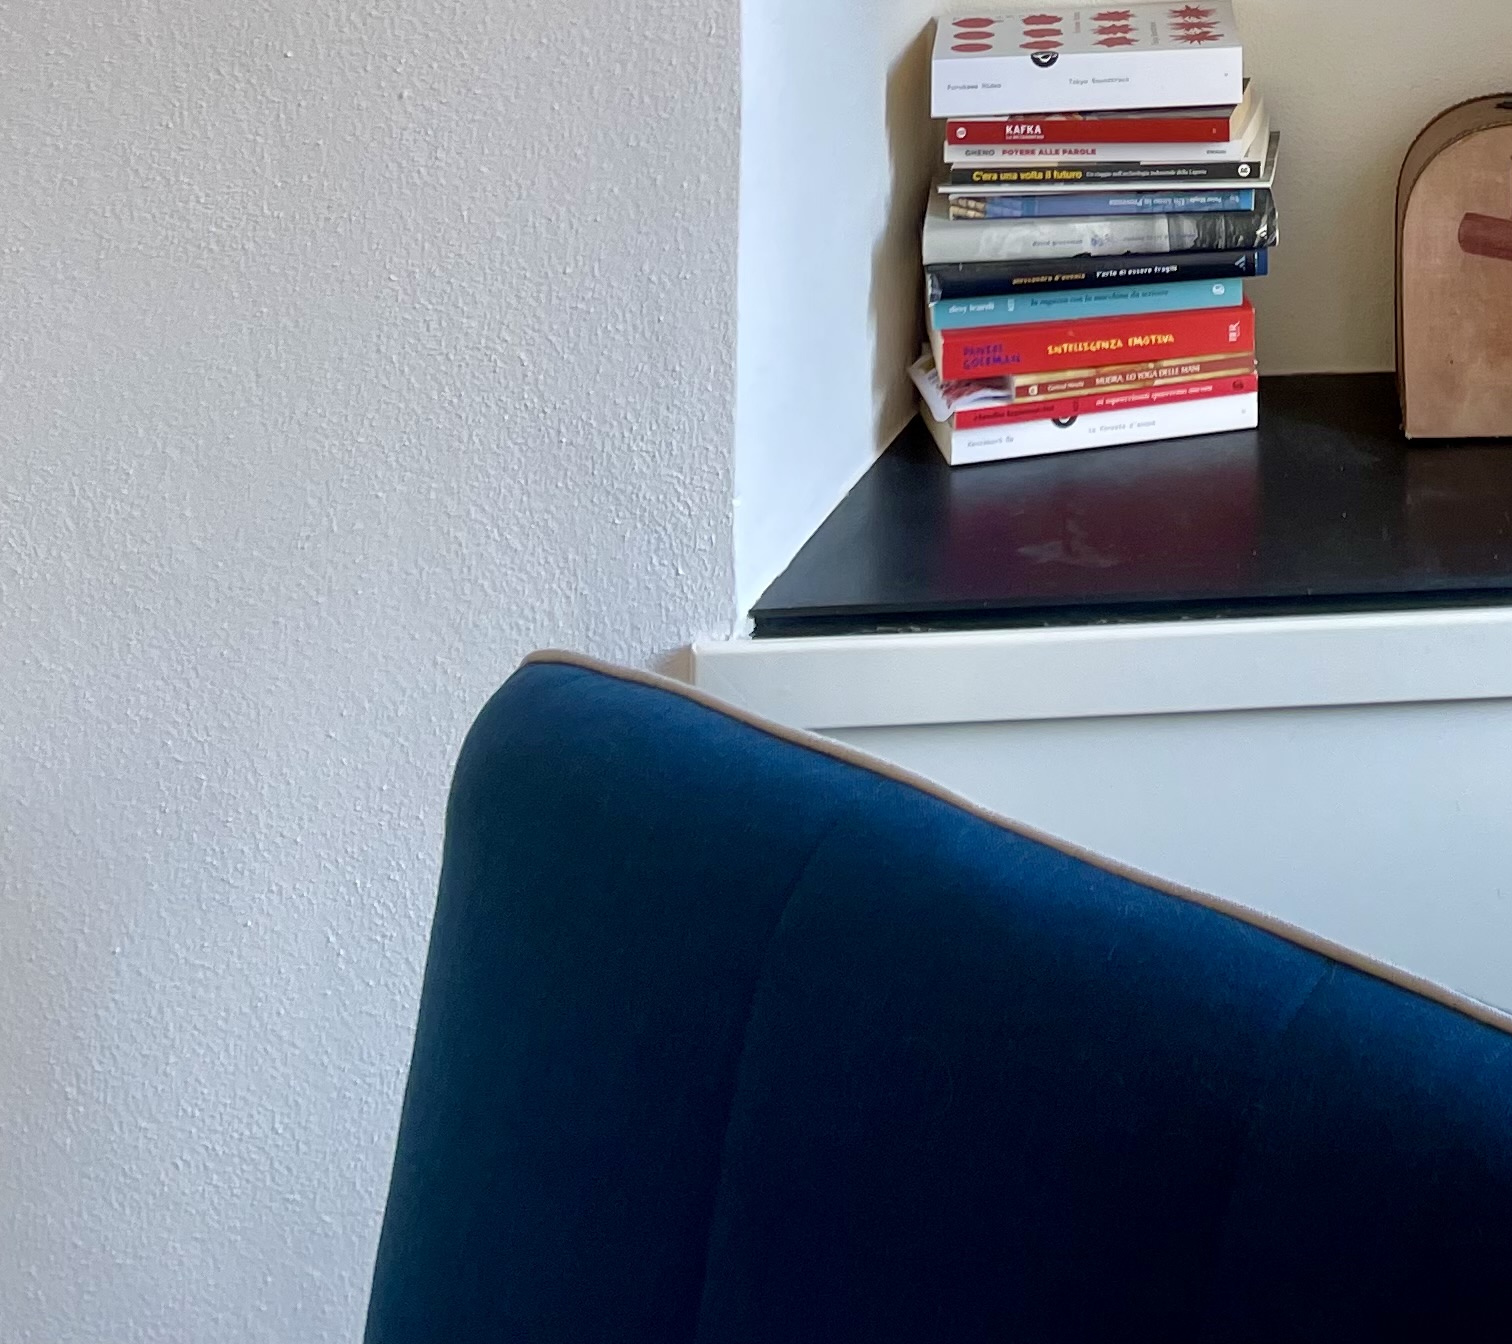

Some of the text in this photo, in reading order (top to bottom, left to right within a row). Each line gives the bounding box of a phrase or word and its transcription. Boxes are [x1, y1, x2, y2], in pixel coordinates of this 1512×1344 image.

[1005, 124, 1042, 135] KAFKA
[972, 169, 1082, 181] C'era una volta il futuro
[1047, 333, 1175, 356] INTELLIGENZA EMOTIVA
[1159, 368, 1179, 378] DELLE
